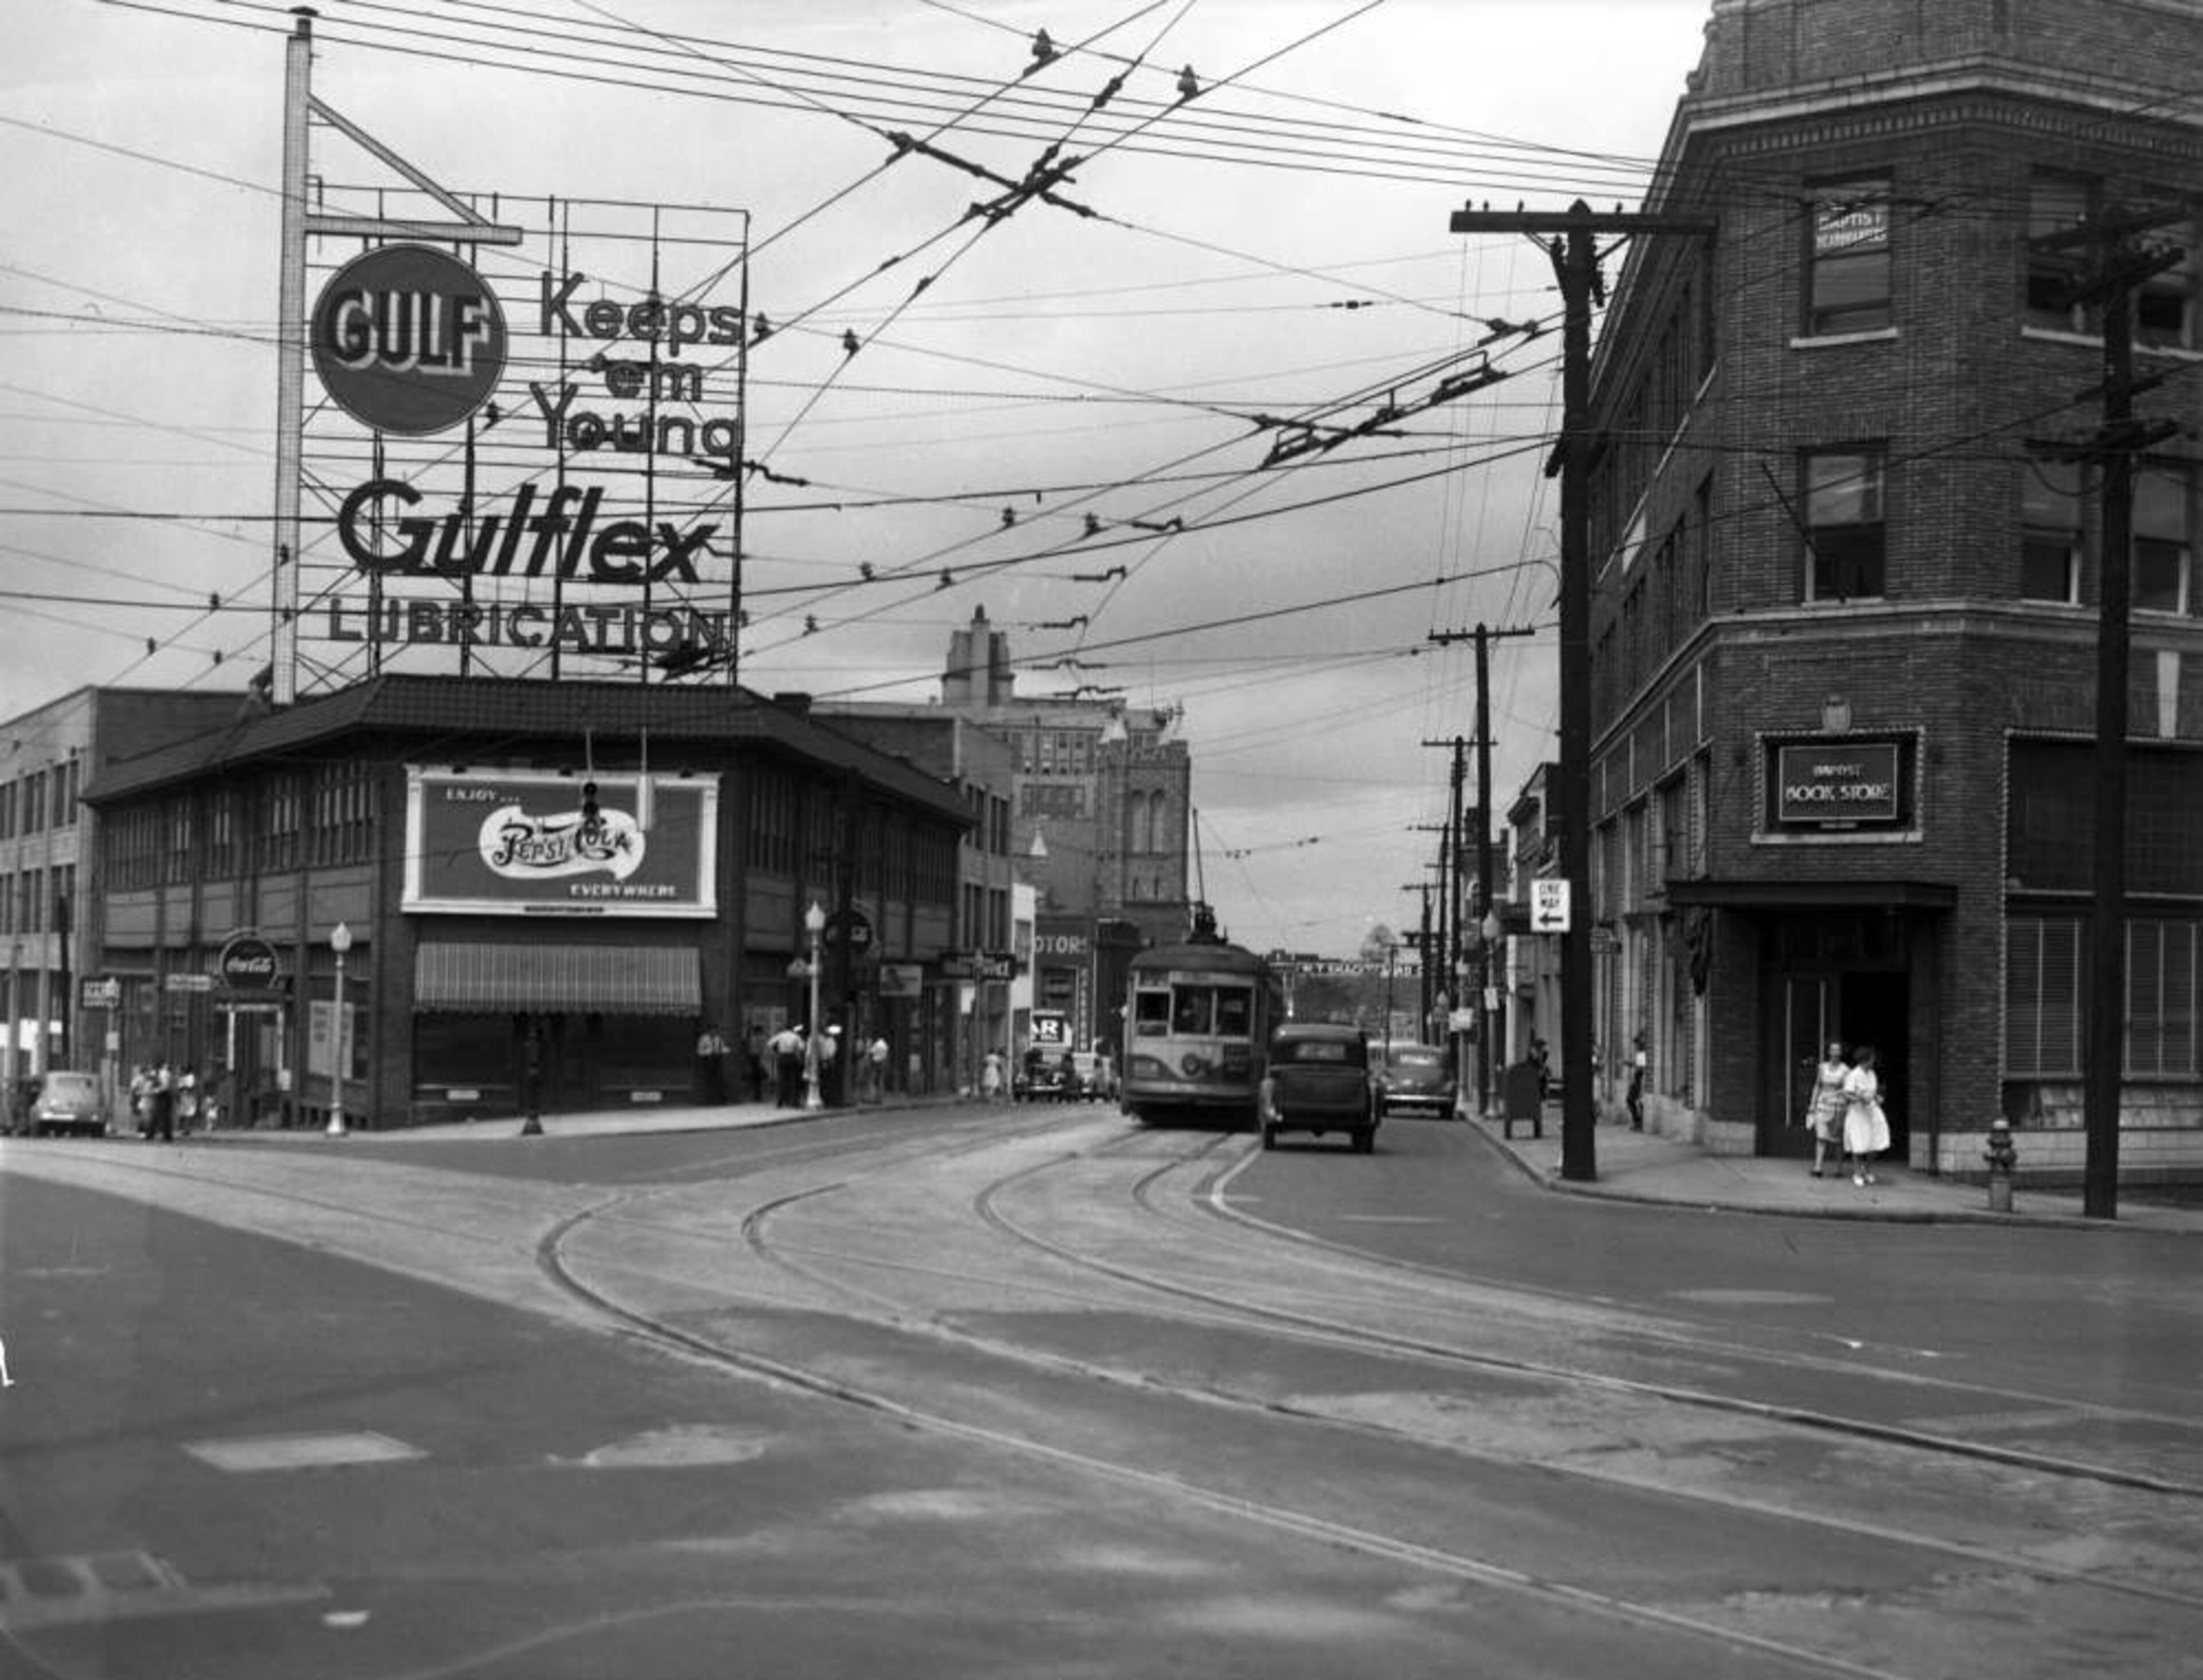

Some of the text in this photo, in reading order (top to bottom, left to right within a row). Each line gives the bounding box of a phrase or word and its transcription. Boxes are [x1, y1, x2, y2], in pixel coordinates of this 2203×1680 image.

[329, 289, 492, 376] GULF
[541, 271, 744, 356] Keeps
[529, 381, 741, 478] Young
[338, 478, 721, 584] Gulflex
[329, 598, 730, 653] LUBRICATION
[1785, 784, 1889, 801] BOOK STORE
[1539, 882, 1561, 894] ONE
[1034, 936, 1088, 954] OTORS
